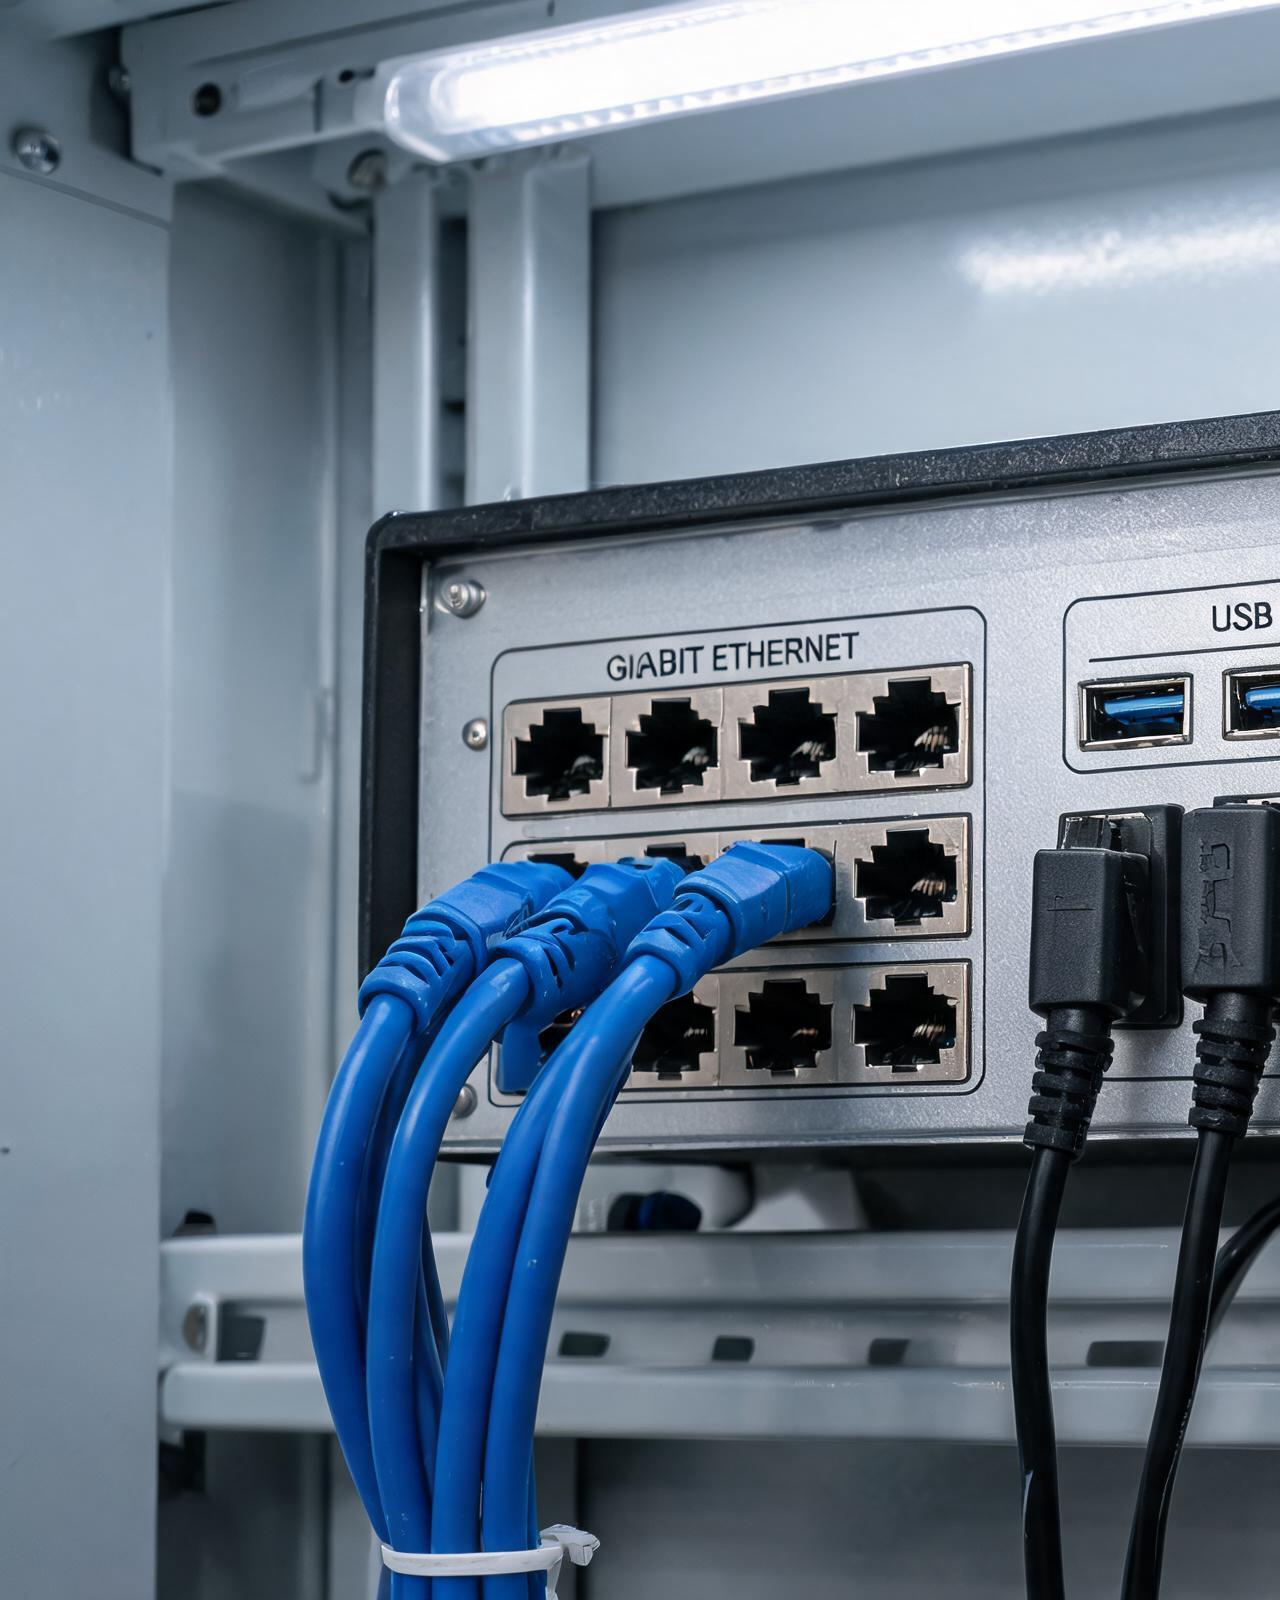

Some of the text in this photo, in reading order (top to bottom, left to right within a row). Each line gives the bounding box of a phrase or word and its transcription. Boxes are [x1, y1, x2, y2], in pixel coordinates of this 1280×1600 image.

[1212, 601, 1273, 632] USB
[606, 632, 860, 681] GIABIT ETHERNET
